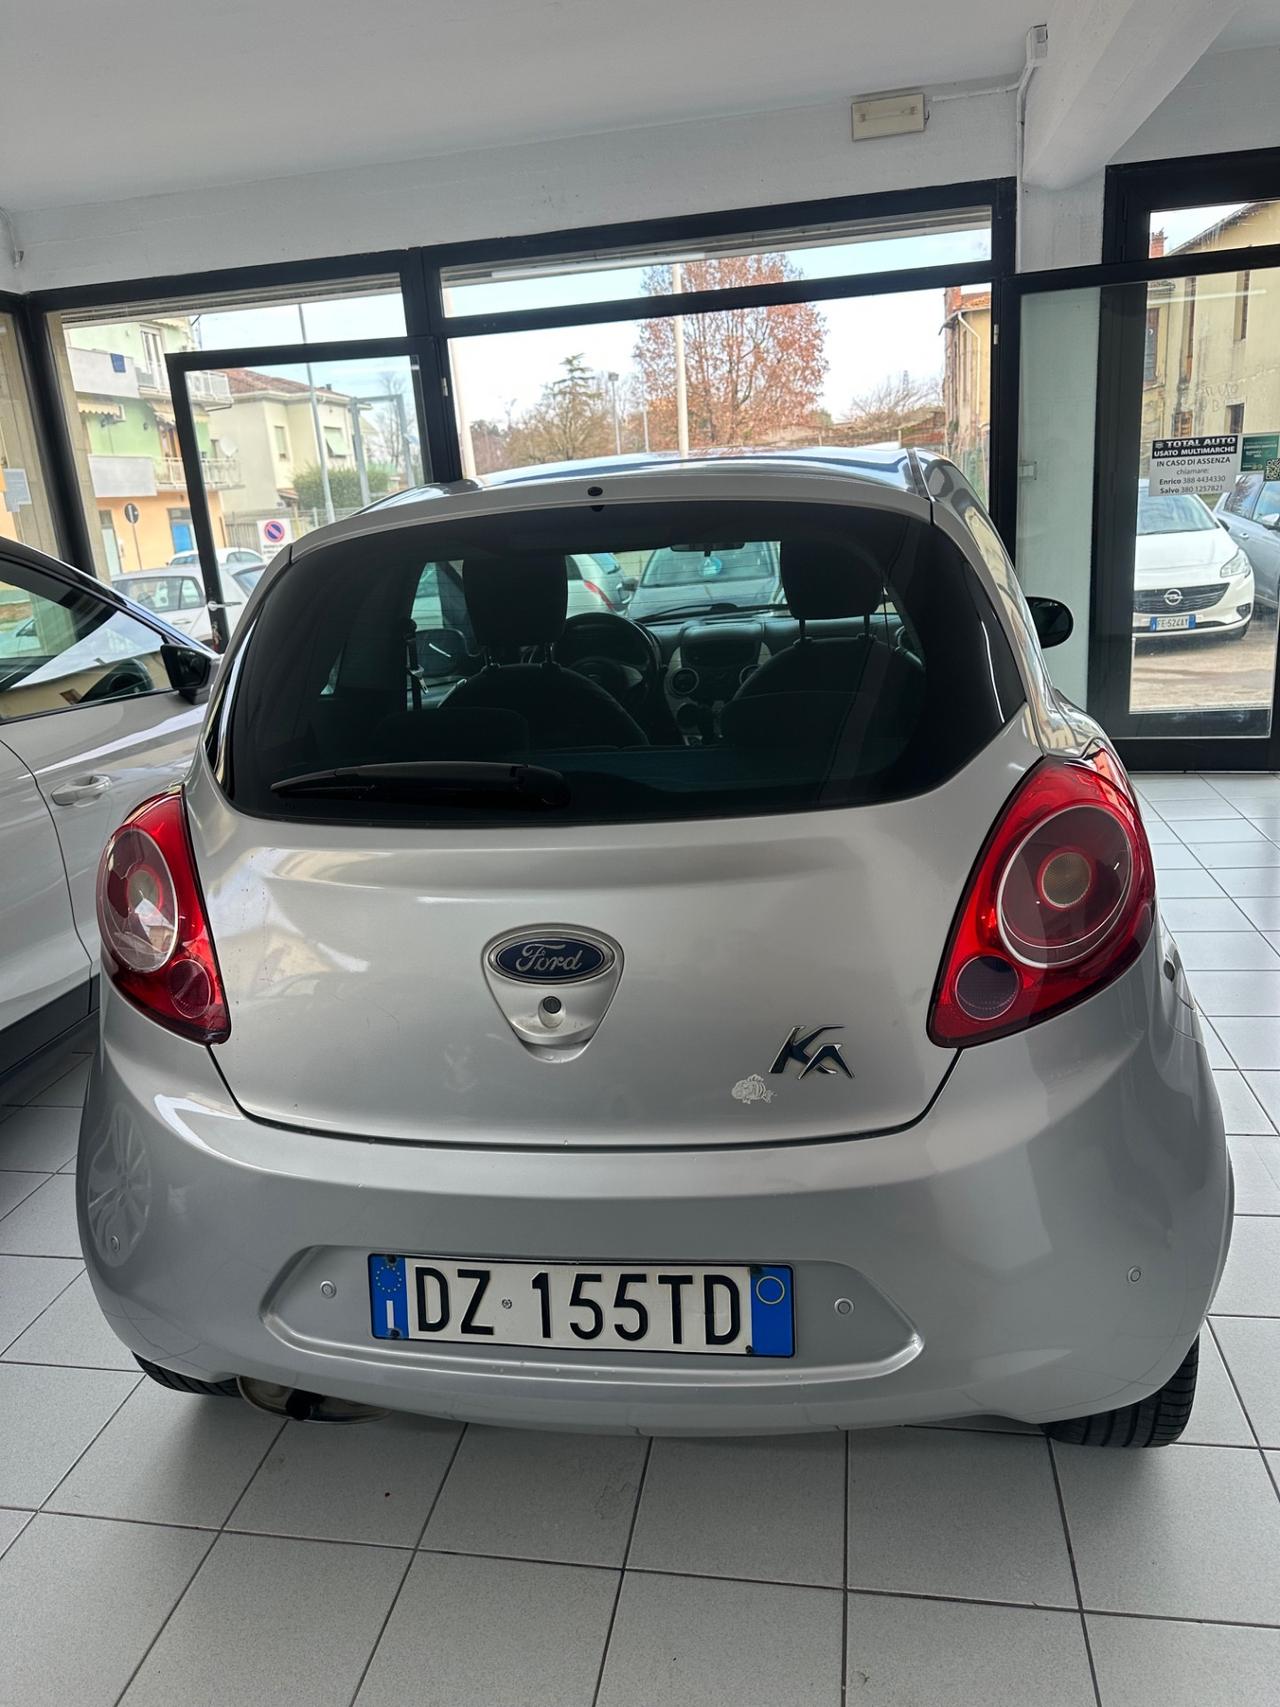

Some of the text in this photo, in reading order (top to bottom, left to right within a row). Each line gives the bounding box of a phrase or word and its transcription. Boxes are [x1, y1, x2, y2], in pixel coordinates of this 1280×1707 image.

[1166, 439, 1200, 449] TOTAL
[1203, 437, 1236, 446] AUTO
[1181, 446, 1235, 455] MULTIMARCHE
[1197, 457, 1231, 465] ASSENZA
[515, 943, 583, 972] Ford
[415, 1266, 494, 1336] DZ
[532, 1271, 741, 1346] 155TD
